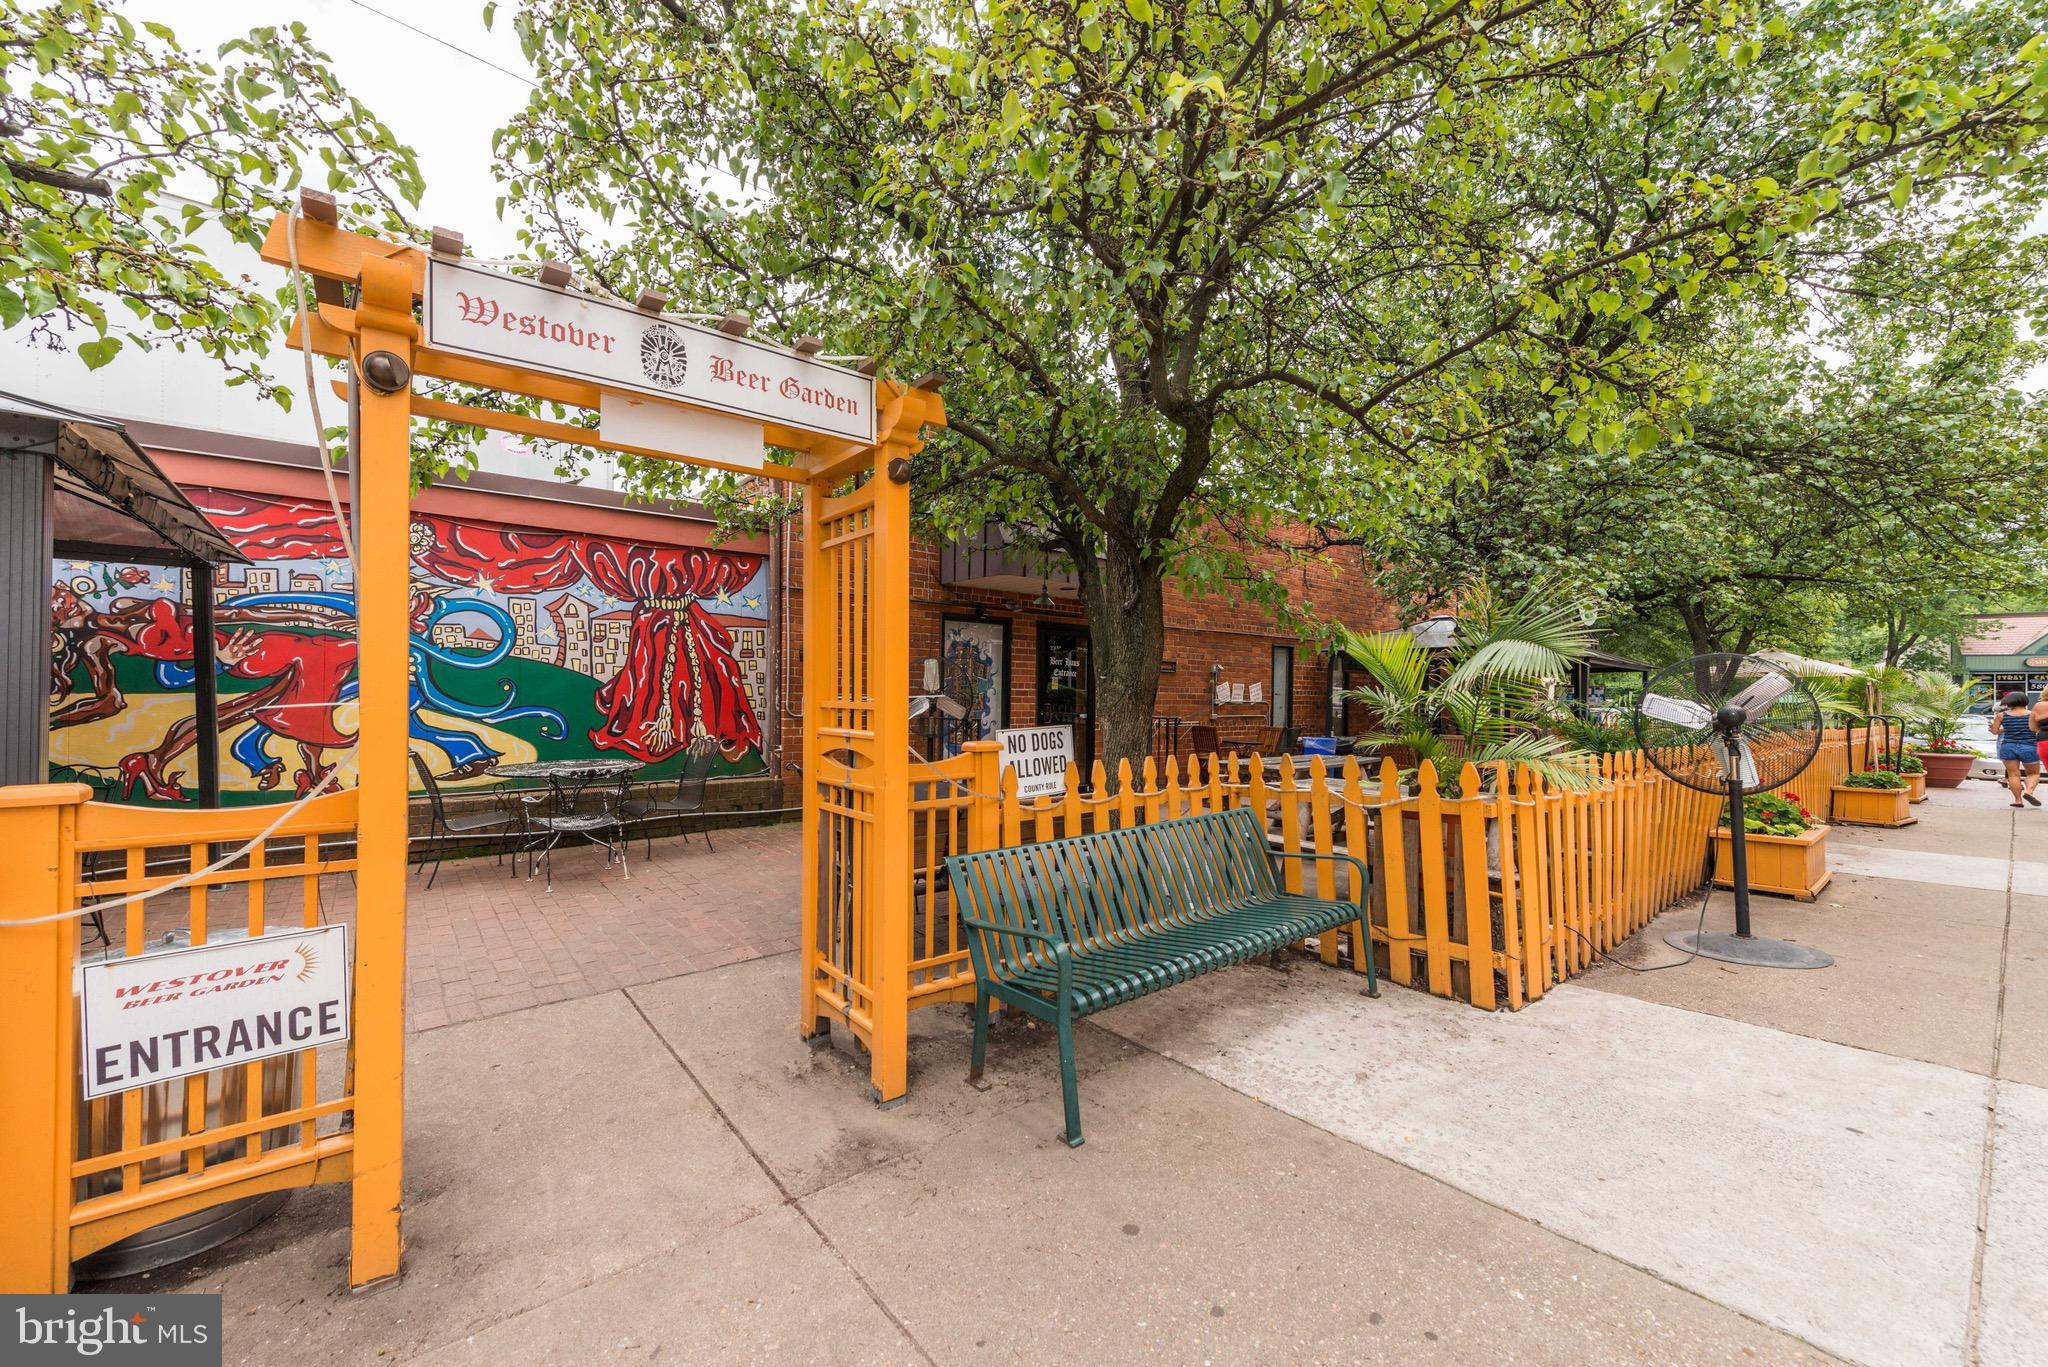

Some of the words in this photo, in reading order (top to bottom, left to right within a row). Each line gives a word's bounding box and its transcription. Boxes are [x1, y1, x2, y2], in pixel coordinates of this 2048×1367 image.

[456, 291, 616, 354] Westover
[709, 354, 770, 393] Beer
[779, 374, 859, 416] Garden
[1007, 734, 1027, 754] NO
[1031, 731, 1063, 751] DOGS
[1024, 783, 1045, 793] COUNTY
[1046, 781, 1057, 789] RULE
[115, 959, 290, 999] WESTOVER
[121, 992, 183, 1010] BEER
[189, 973, 285, 997] GARDEN
[95, 999, 341, 1086] ENTRANCE
